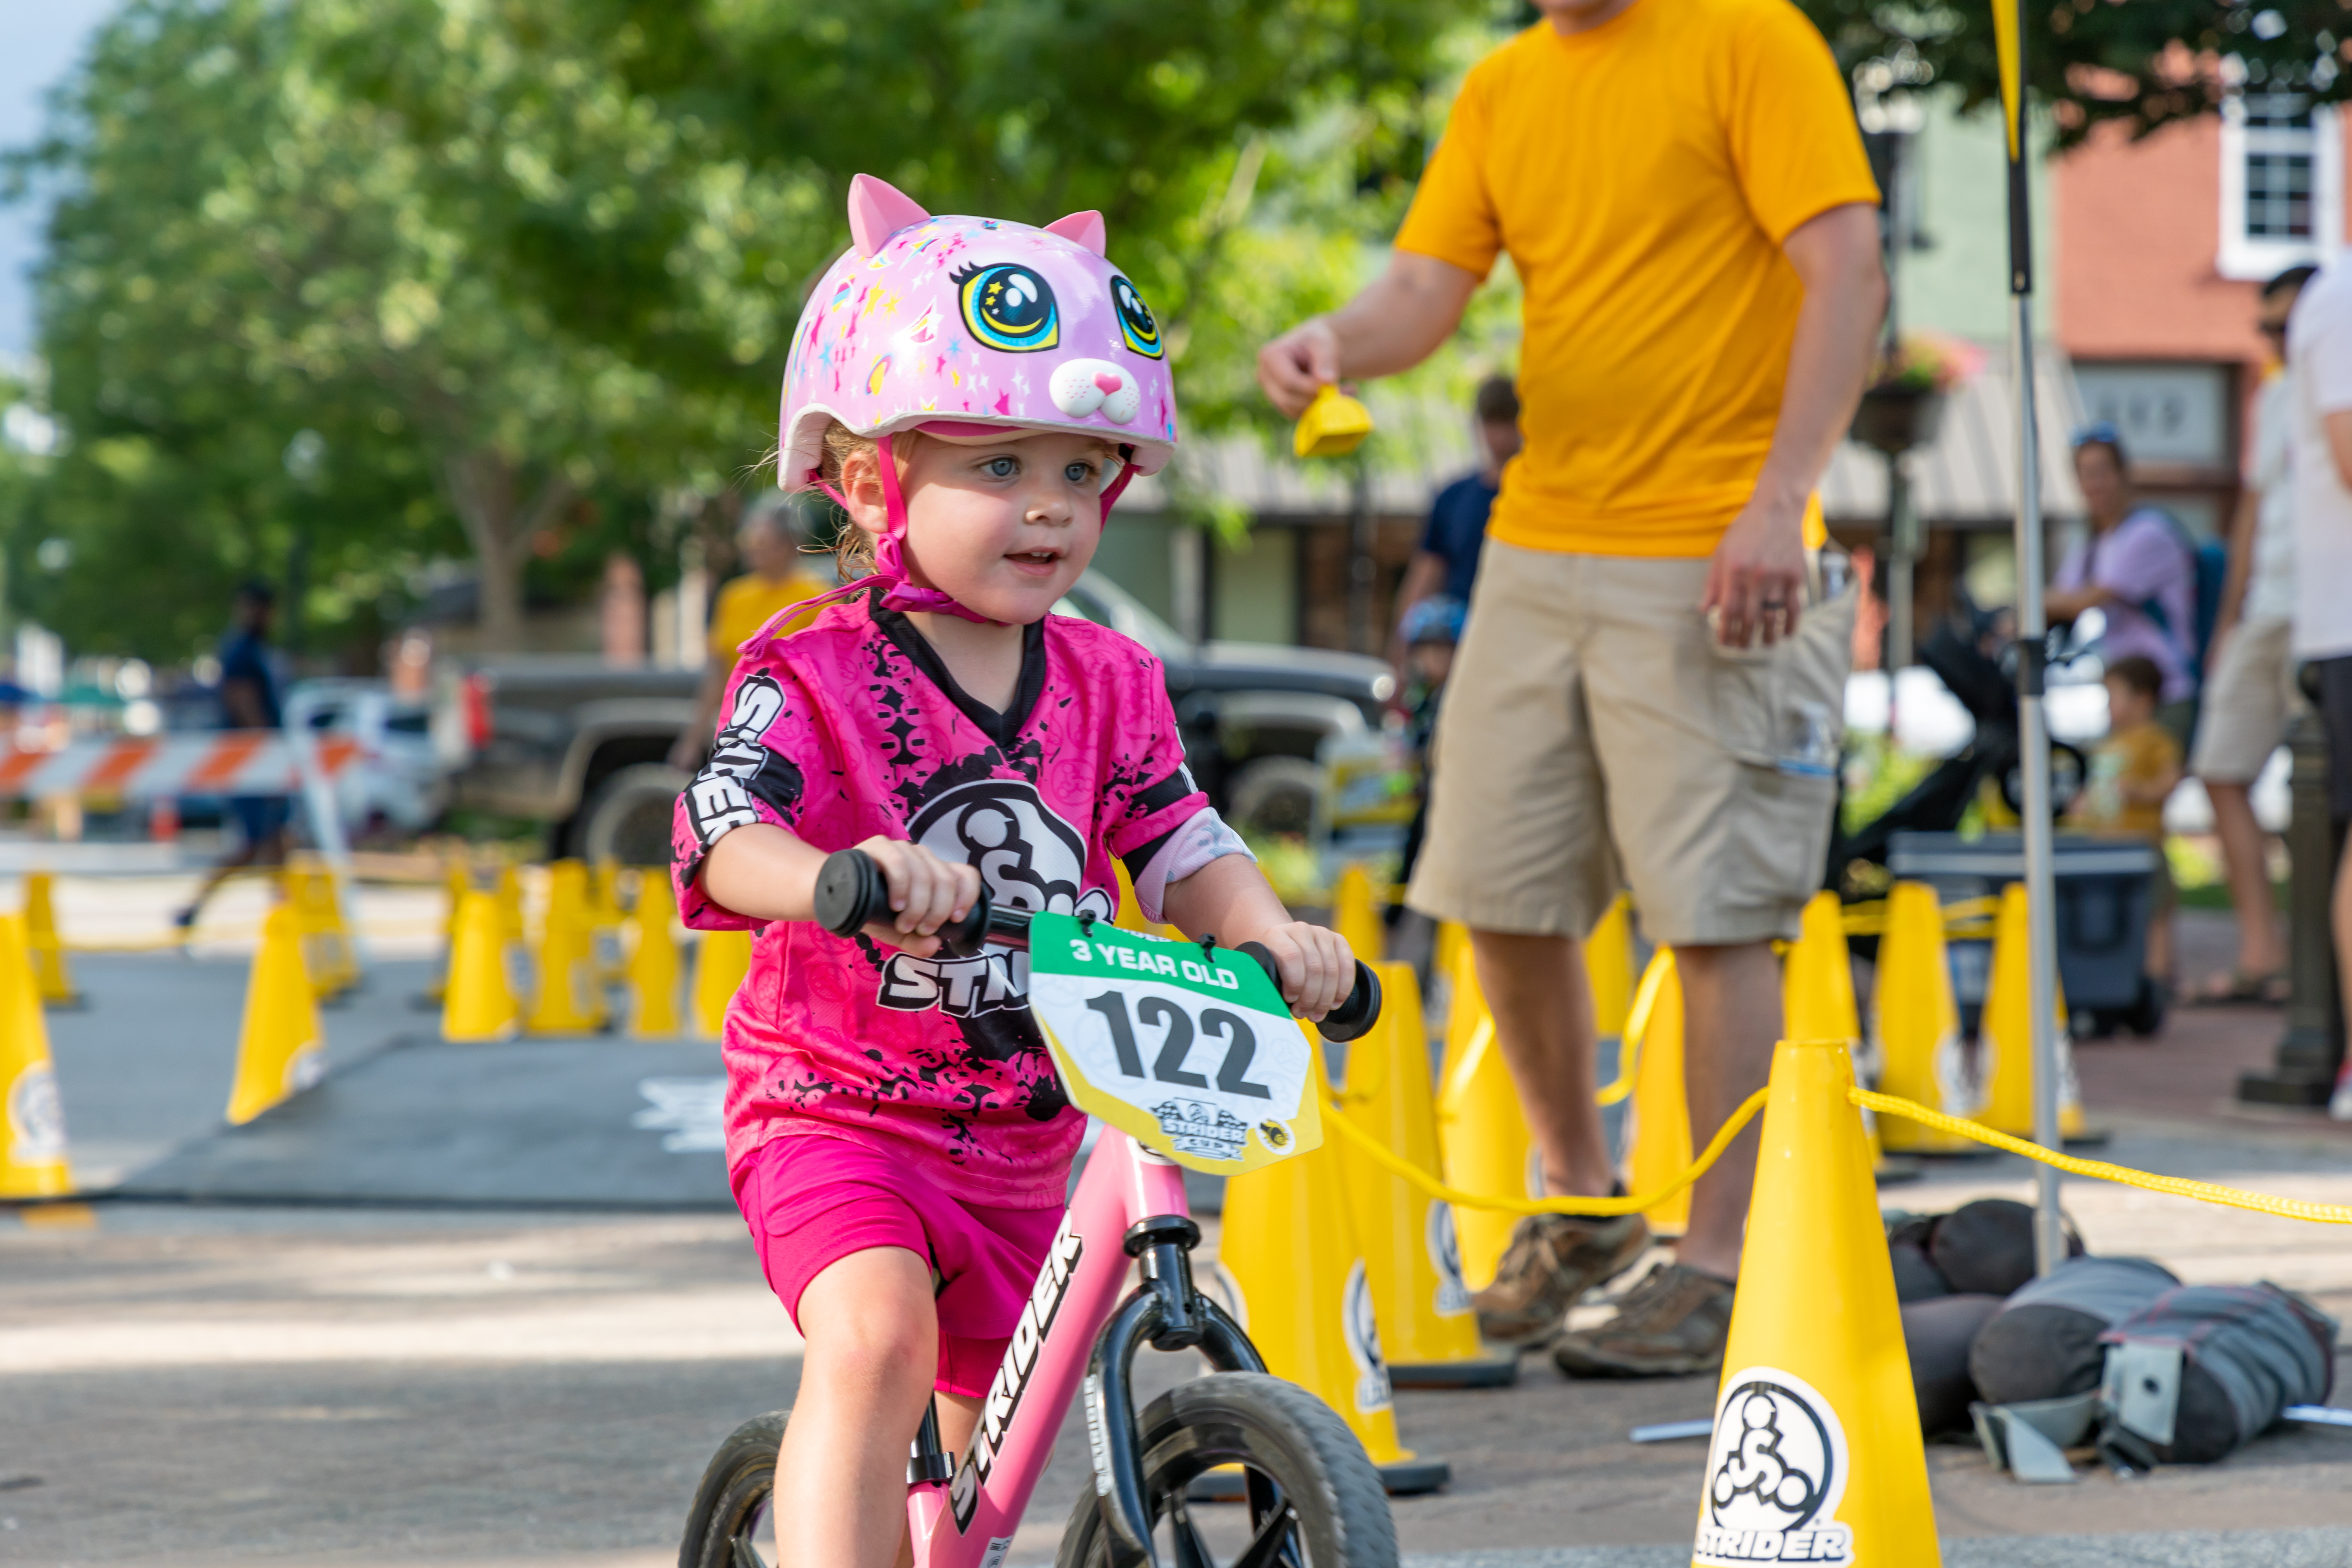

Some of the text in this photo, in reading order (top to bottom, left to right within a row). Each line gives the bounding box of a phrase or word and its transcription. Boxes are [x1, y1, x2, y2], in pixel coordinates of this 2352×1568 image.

[1069, 939, 1239, 990] 3 YEAR OLD
[1084, 990, 1273, 1100] 122
[1163, 1118, 1246, 1144] STRIDER
[1695, 1528, 1847, 1562] STRIDER
